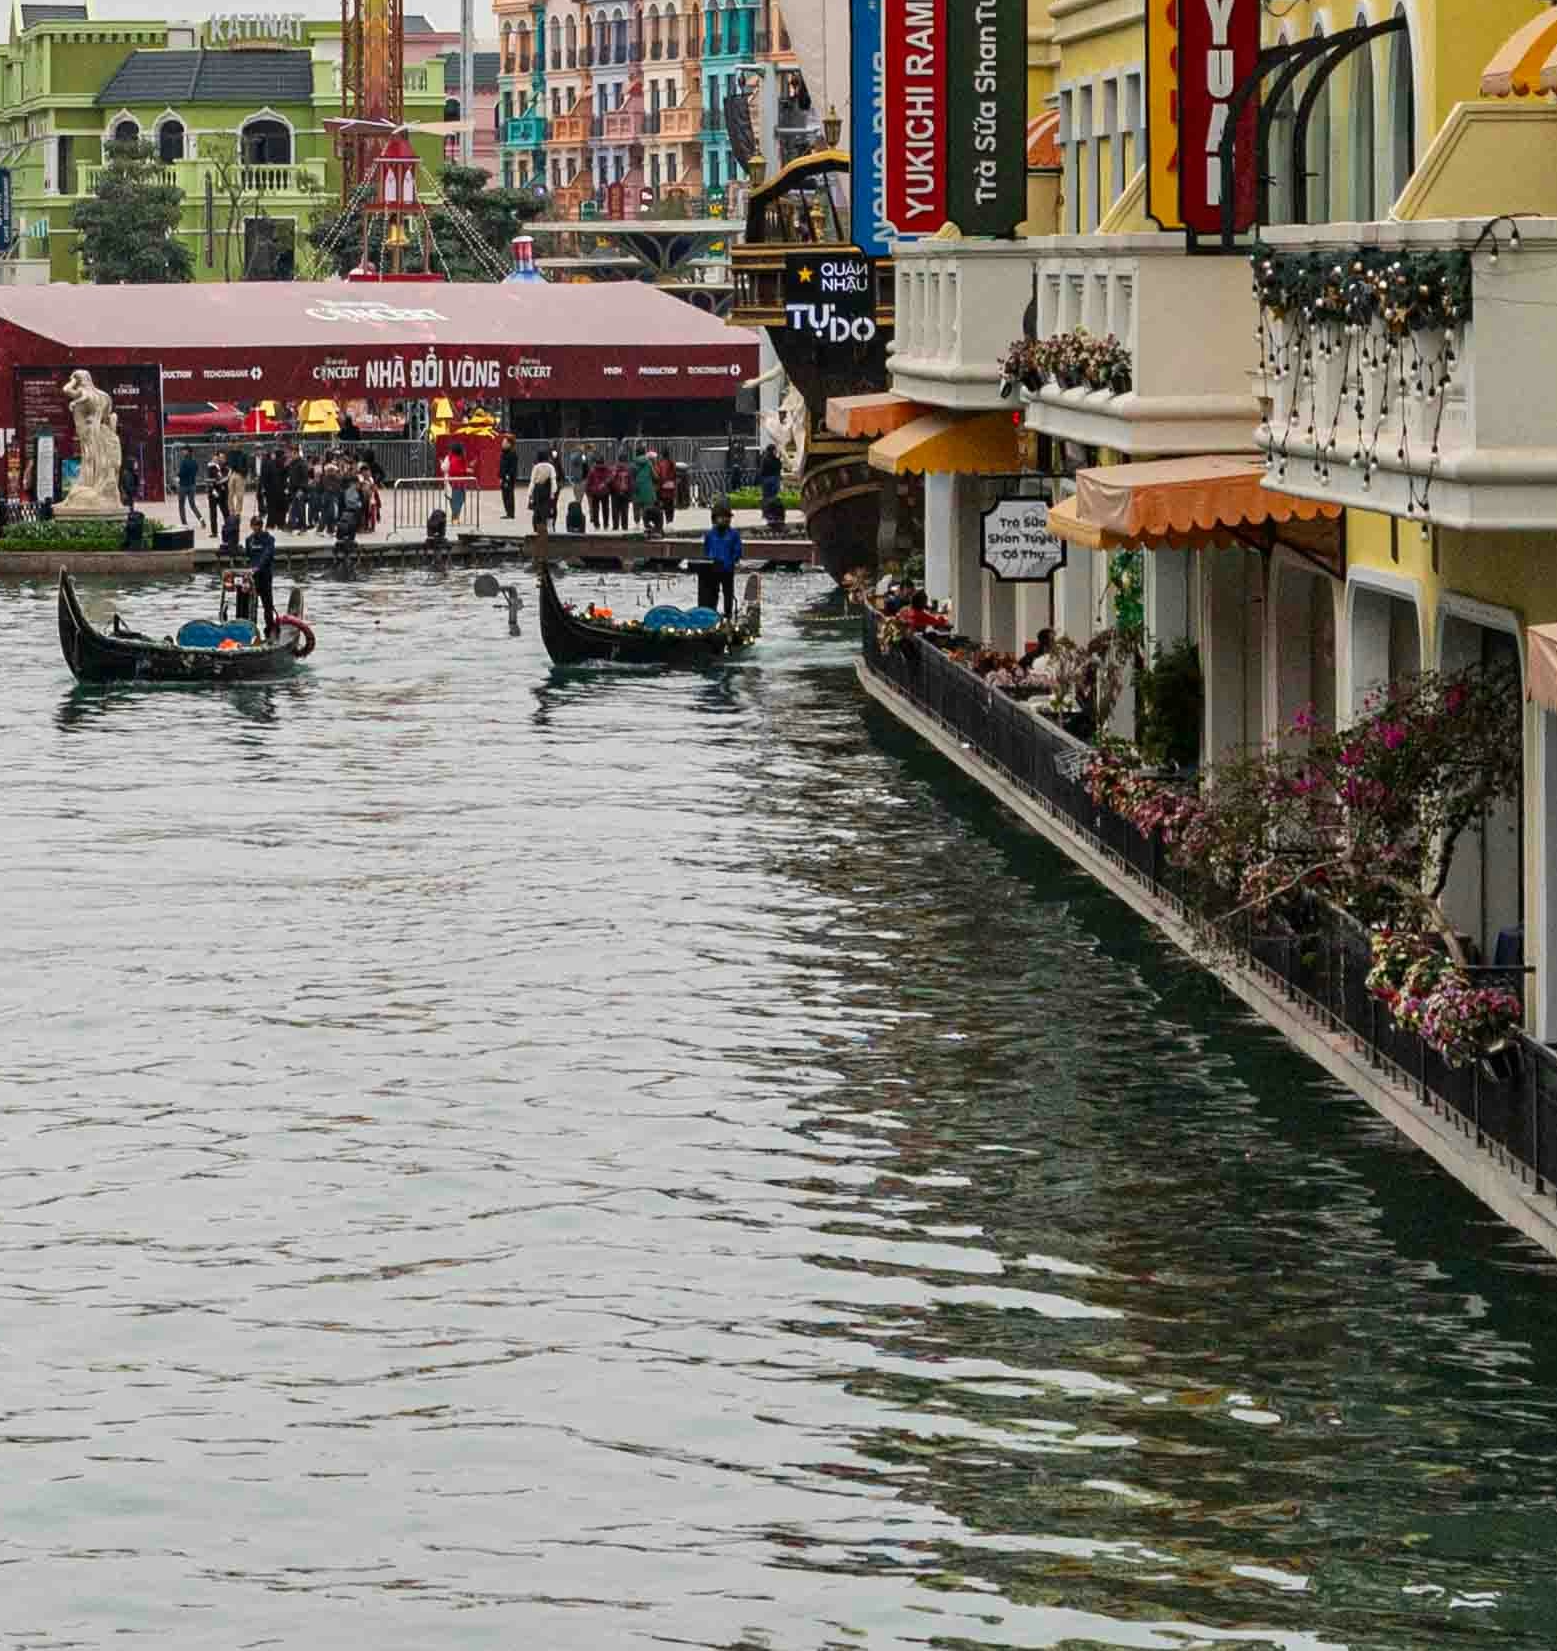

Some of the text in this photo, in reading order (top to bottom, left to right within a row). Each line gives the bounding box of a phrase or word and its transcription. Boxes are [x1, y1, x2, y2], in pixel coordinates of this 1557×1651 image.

[210, 12, 305, 42] KATINAT
[975, 27, 997, 93] Shan
[972, 102, 997, 152] Sữa
[905, 87, 934, 219] YUKICHI
[973, 160, 997, 204] Trà
[830, 317, 876, 342] DO
[366, 356, 406, 388] NHÀ
[448, 356, 500, 388] VÒNG
